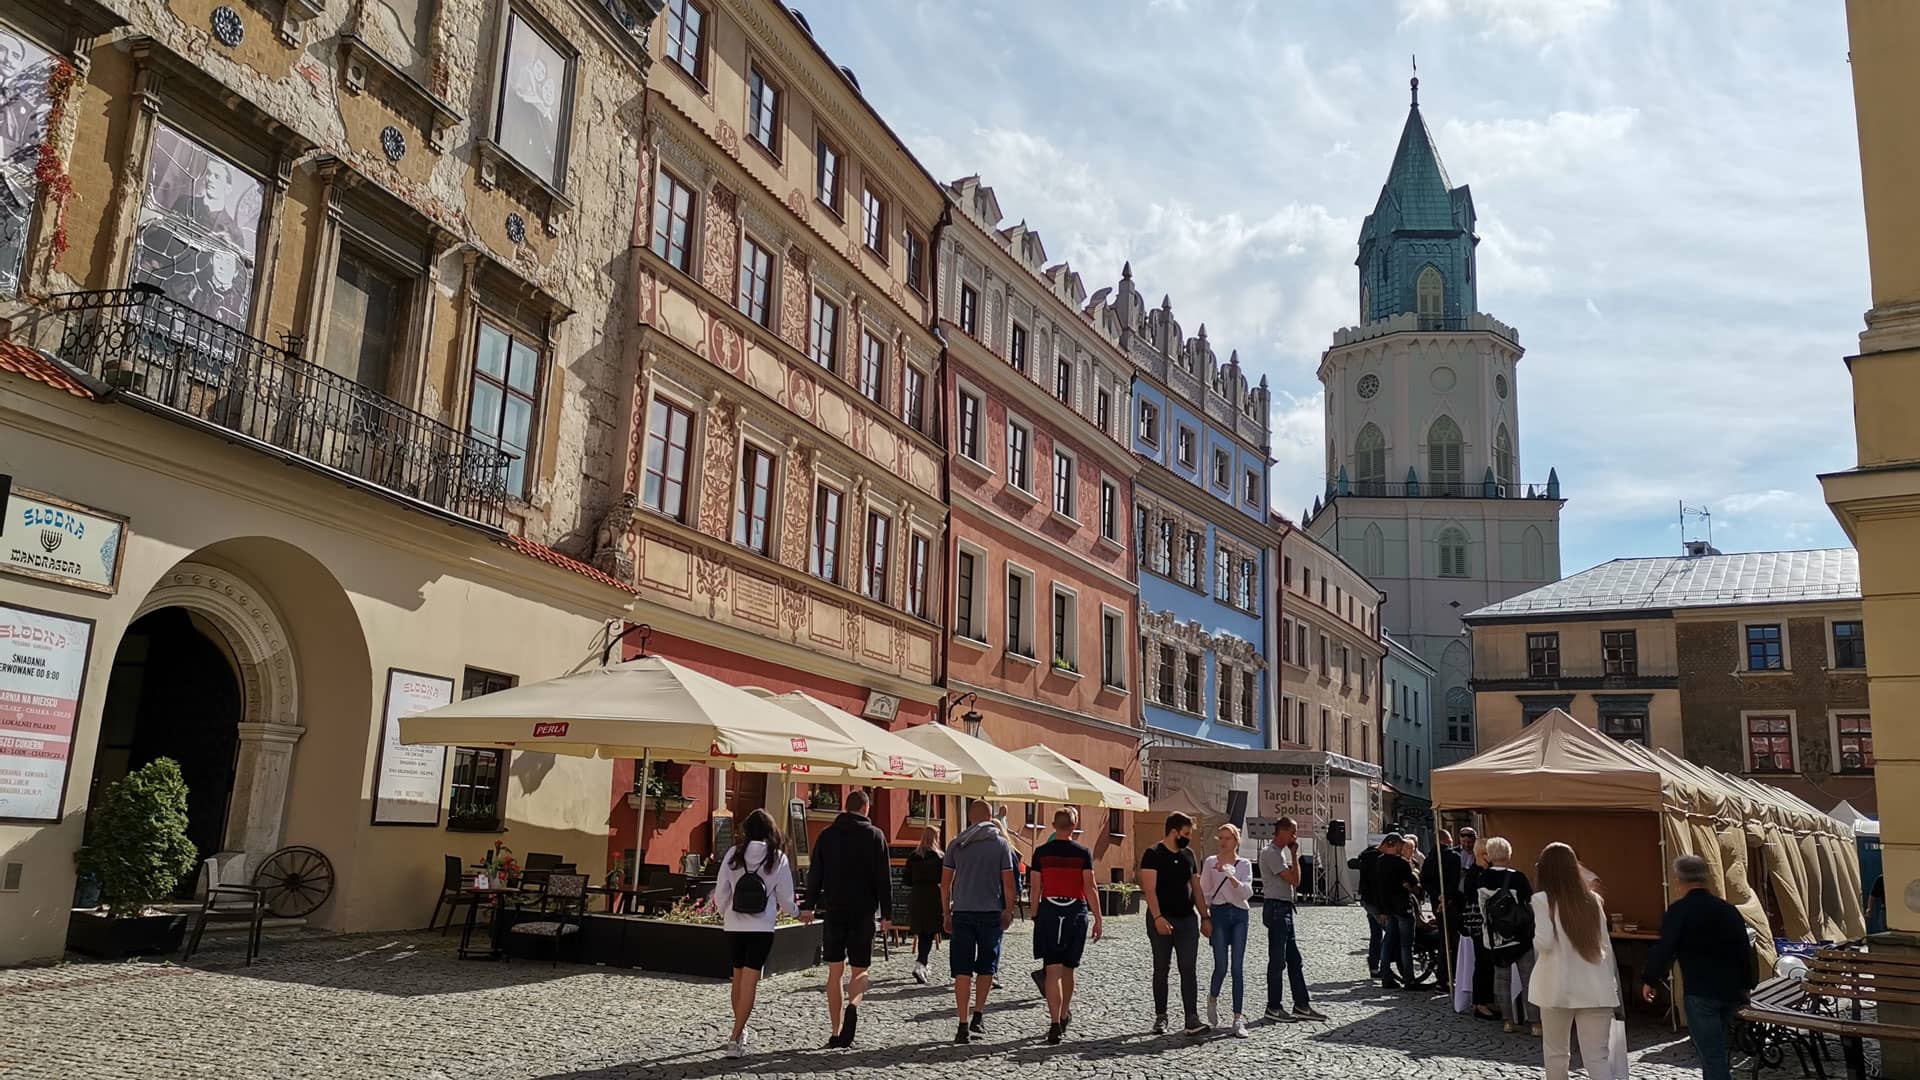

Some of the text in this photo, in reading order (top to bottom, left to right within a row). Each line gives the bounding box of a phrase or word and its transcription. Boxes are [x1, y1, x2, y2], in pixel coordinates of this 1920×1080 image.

[36, 668, 45, 678] OD
[1264, 789, 1345, 804] Targi Ekoomii
